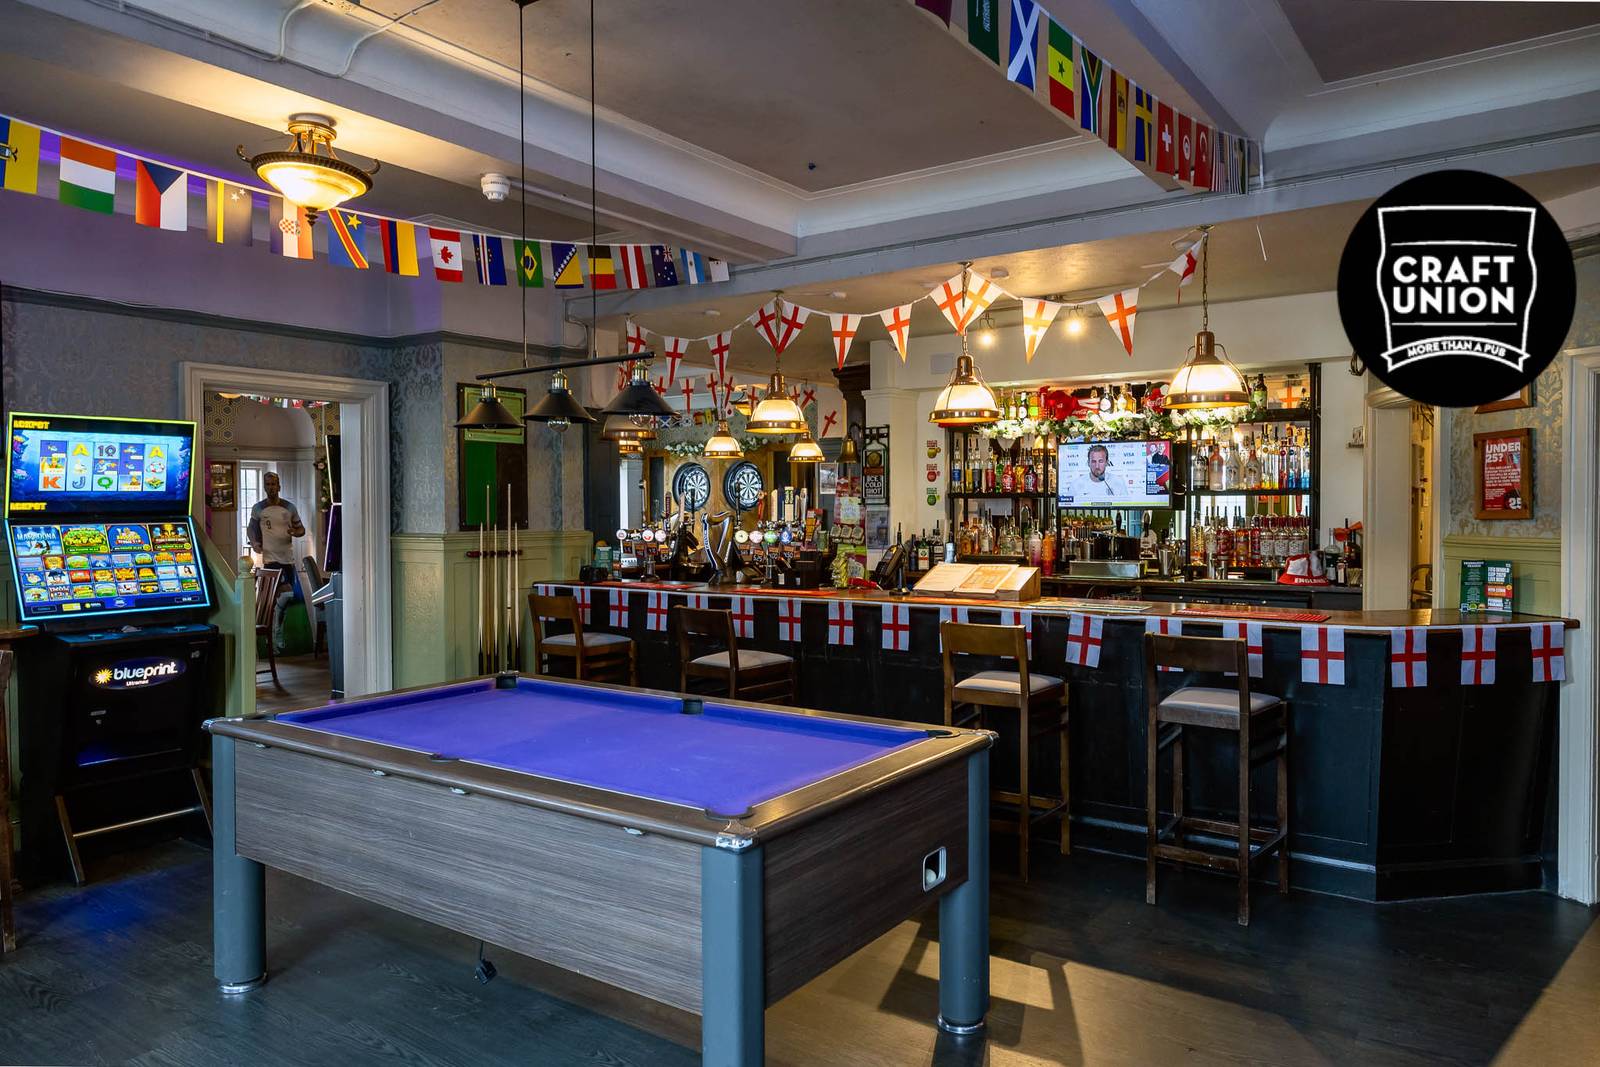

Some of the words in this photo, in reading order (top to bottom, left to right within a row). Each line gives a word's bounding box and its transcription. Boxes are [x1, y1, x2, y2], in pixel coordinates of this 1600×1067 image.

[1487, 442, 1520, 453] UNDER
[1487, 453, 1503, 463] 25?
[43, 476, 61, 489] K
[113, 662, 177, 680] blueprint
